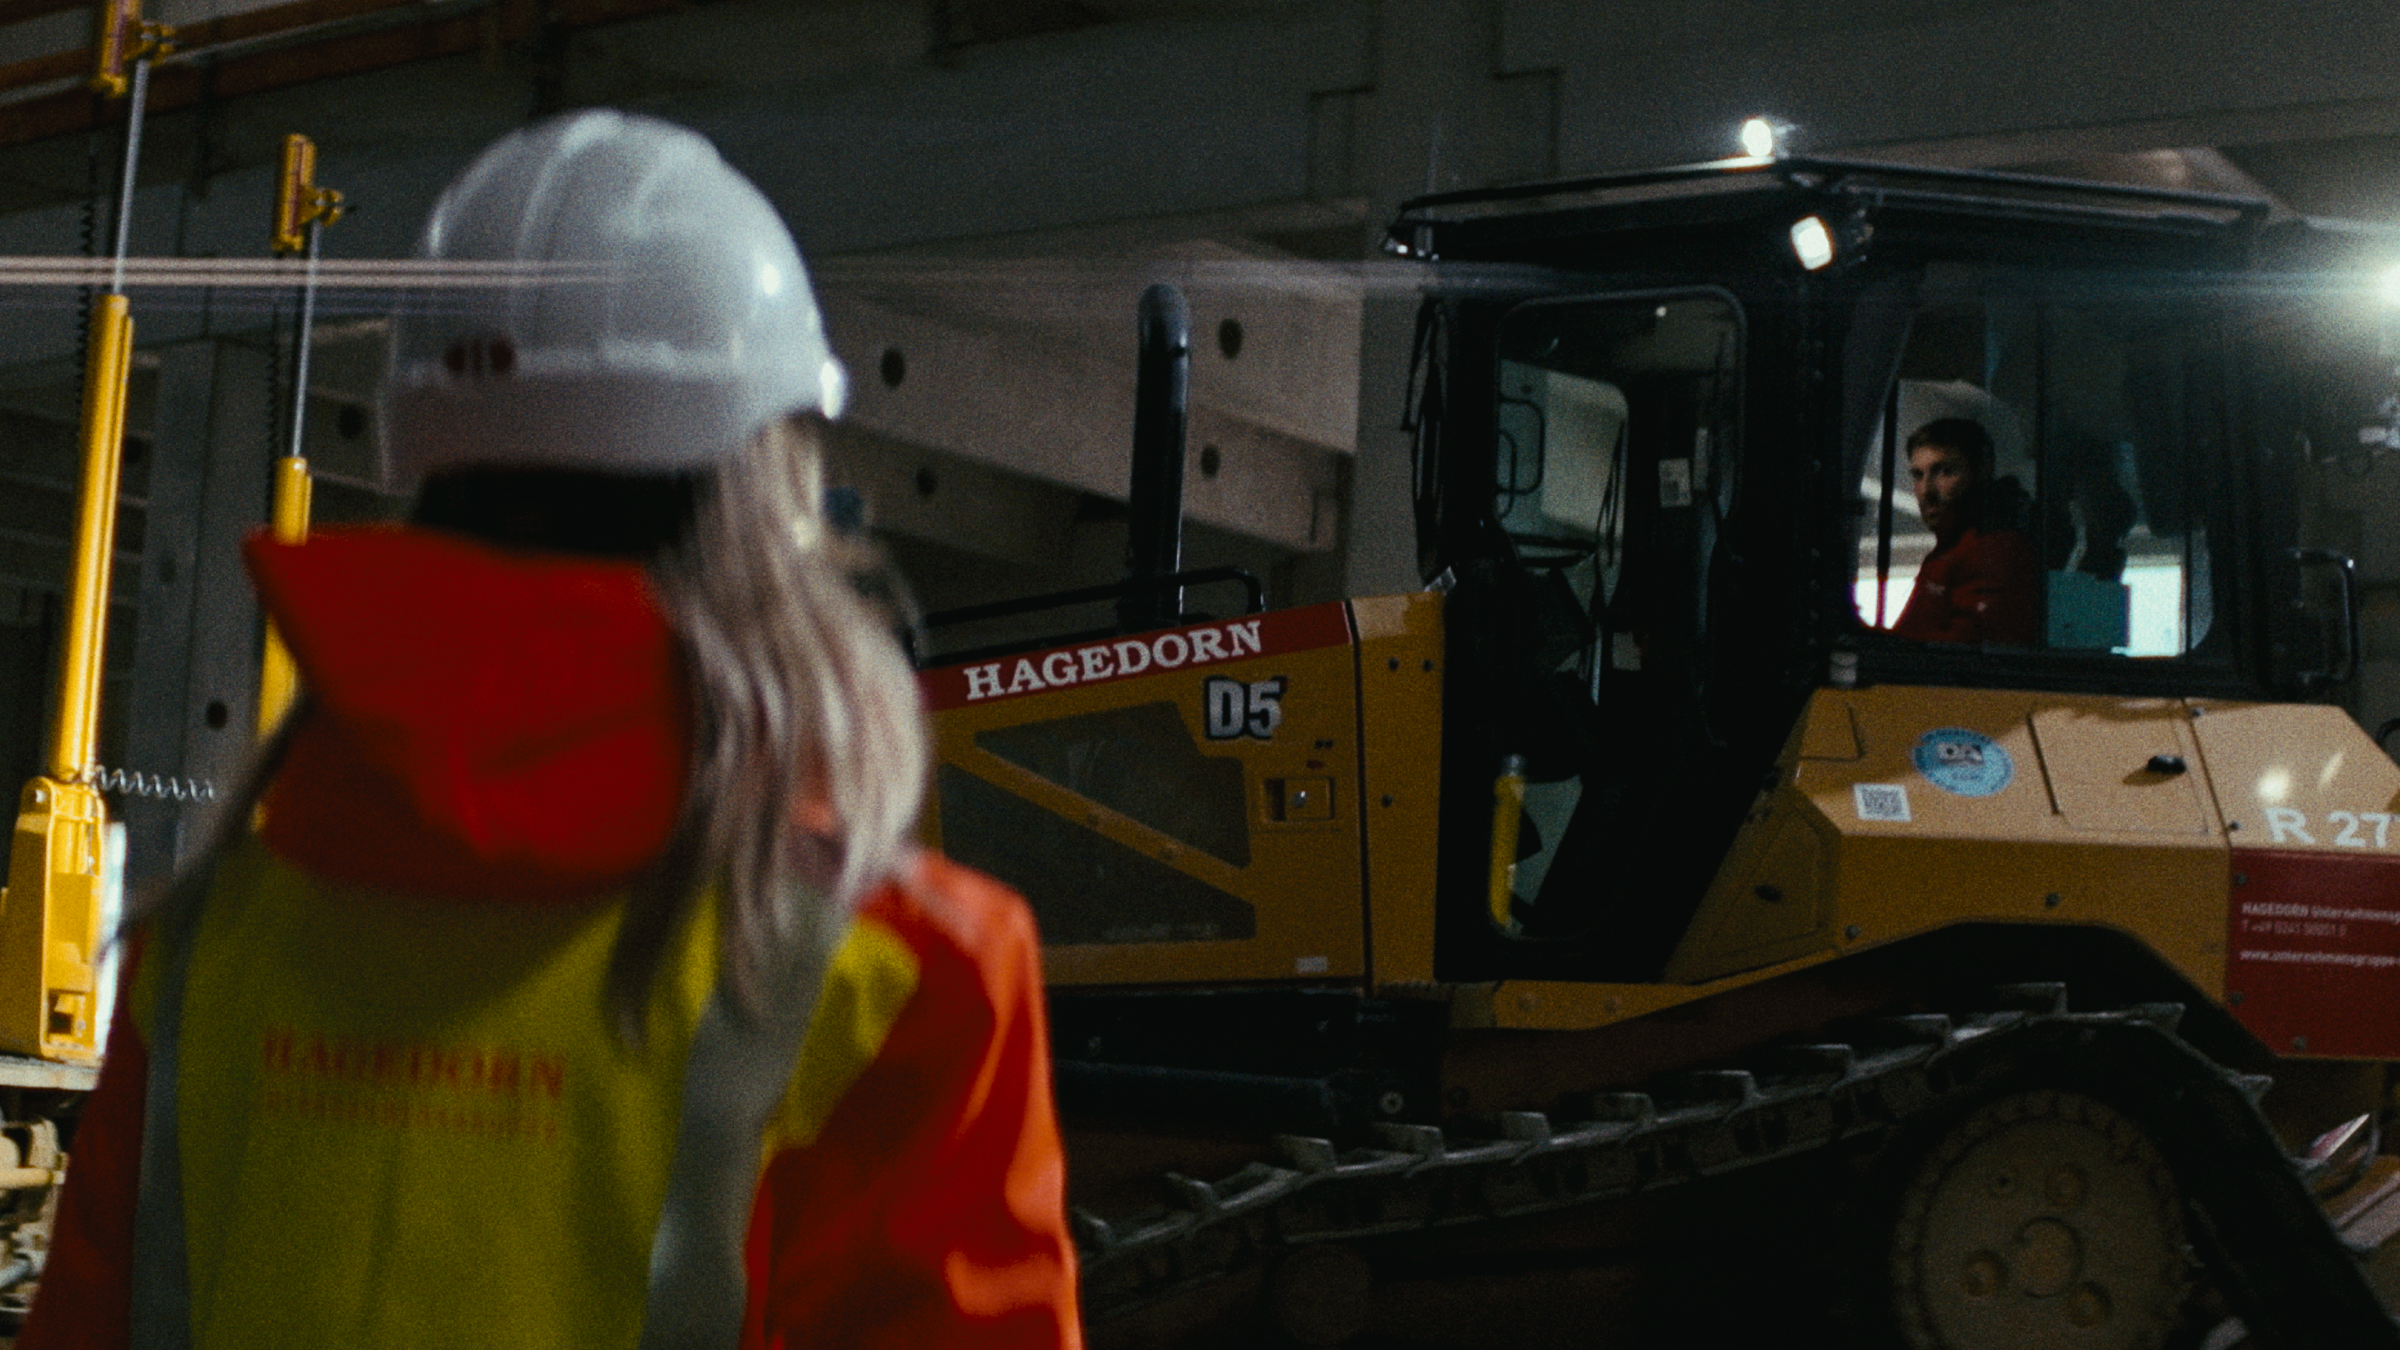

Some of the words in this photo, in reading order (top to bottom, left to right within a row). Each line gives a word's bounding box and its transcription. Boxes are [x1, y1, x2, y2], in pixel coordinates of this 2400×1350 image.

[963, 620, 1262, 701] HAGEDORN
[1208, 678, 1283, 738] D5
[2265, 807, 2316, 845] R
[2327, 810, 2400, 848] 27
[2242, 903, 2309, 918] HAGEDORN
[262, 1030, 566, 1098] HAGEDORN
